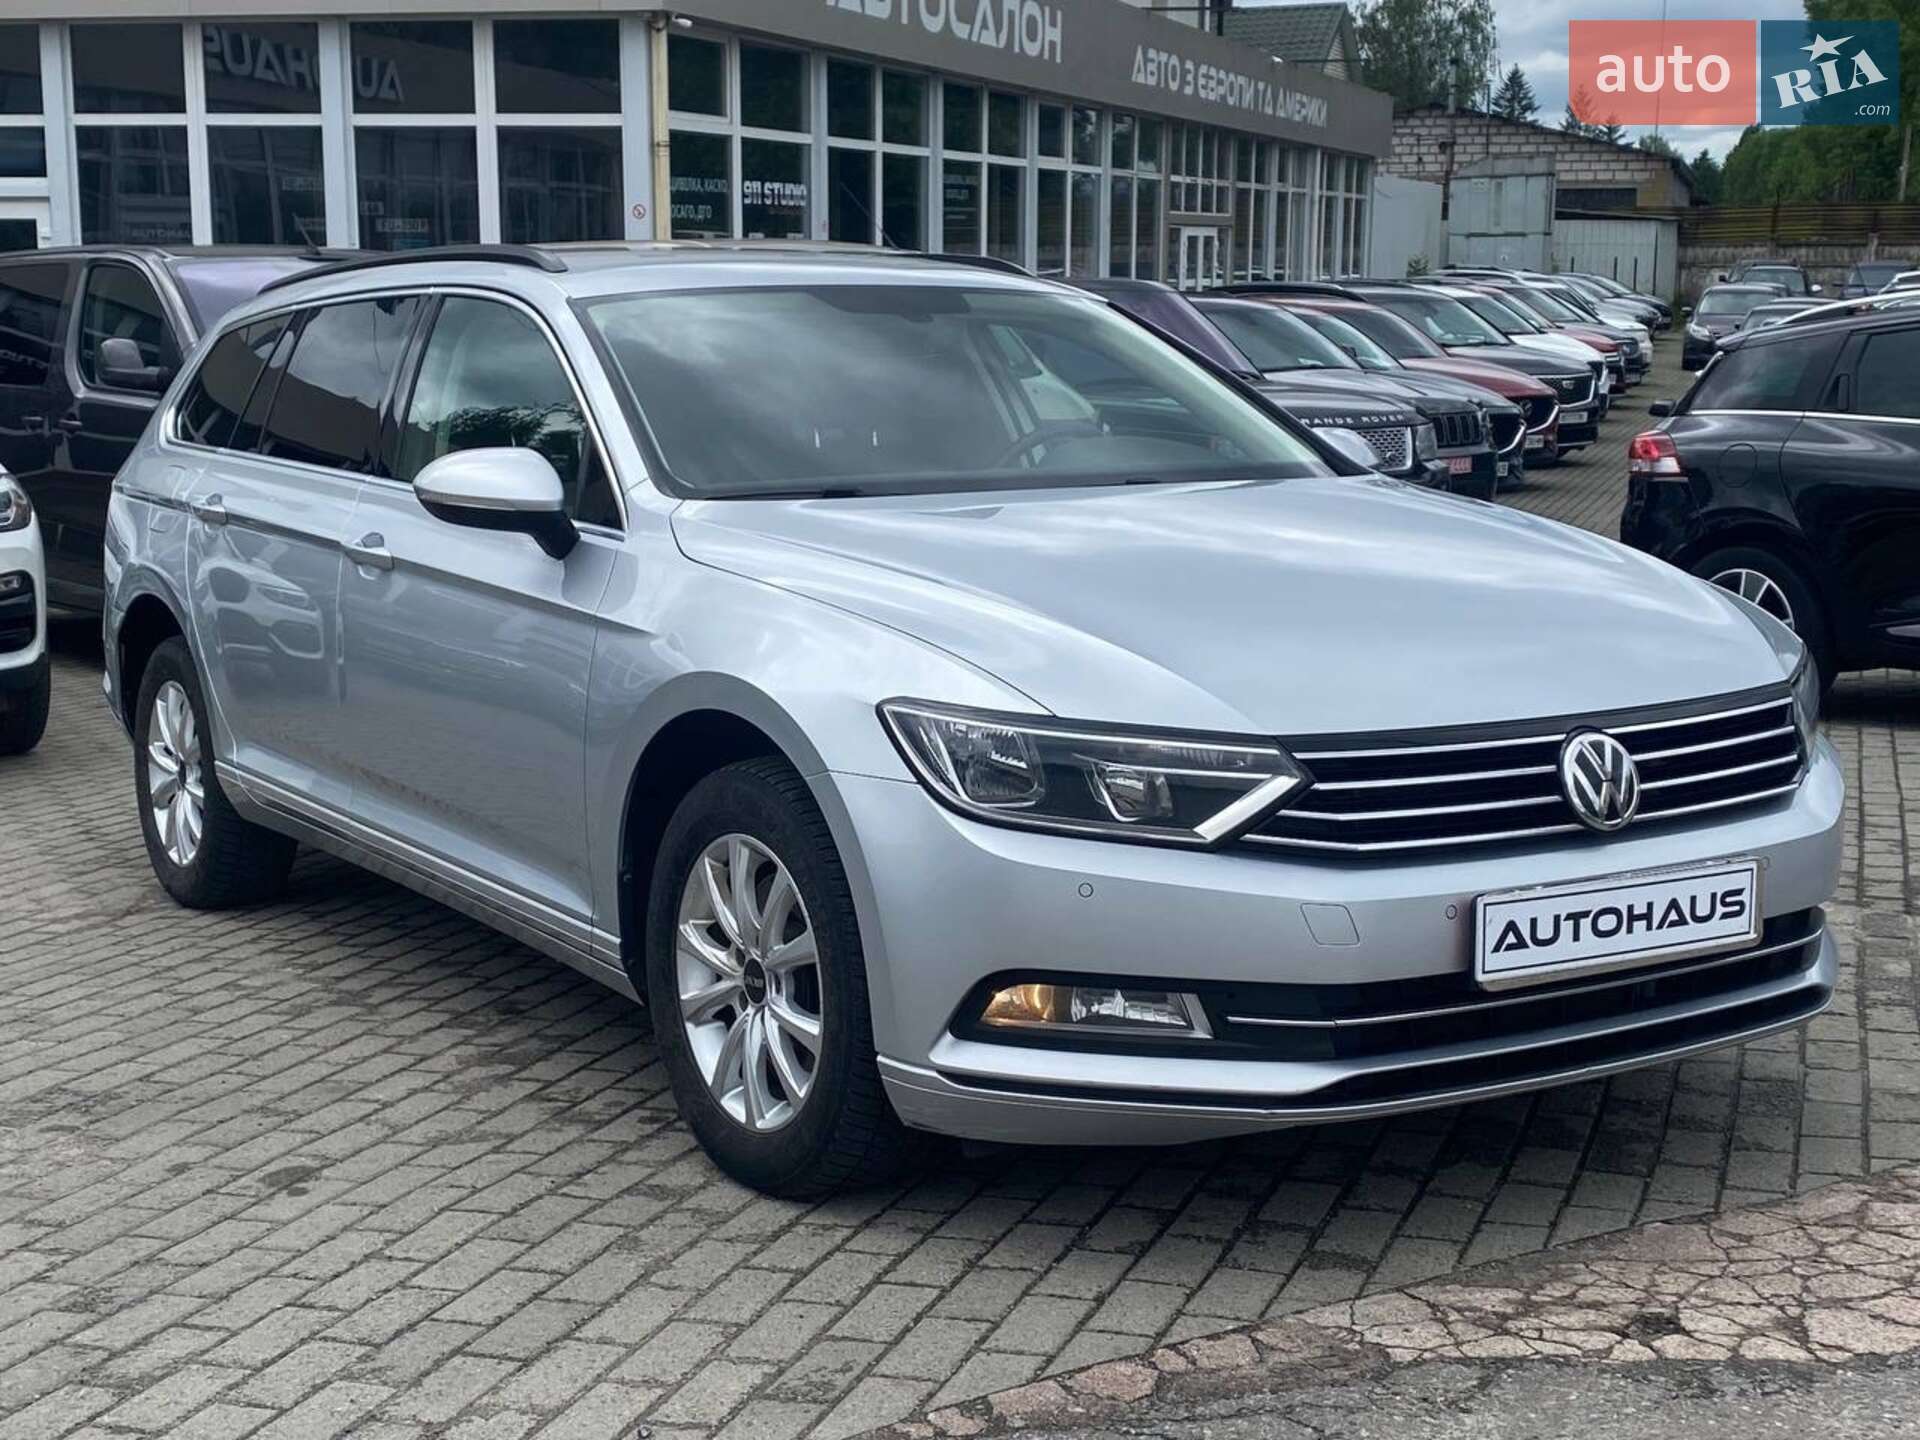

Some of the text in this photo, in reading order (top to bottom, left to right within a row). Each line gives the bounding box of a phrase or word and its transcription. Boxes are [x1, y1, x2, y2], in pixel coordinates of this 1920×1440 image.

[826, 0, 1062, 63] ОСАЛОН
[1131, 45, 1180, 92] АВТО
[1198, 63, 1254, 111] ЄВРОПИ
[1257, 81, 1273, 116] ТА
[1276, 87, 1328, 128] АМЕРИКИ
[743, 180, 807, 207] 911 STUDIO
[1362, 414, 1404, 424] ROVER
[1490, 887, 1746, 954] AUTOHAUS
